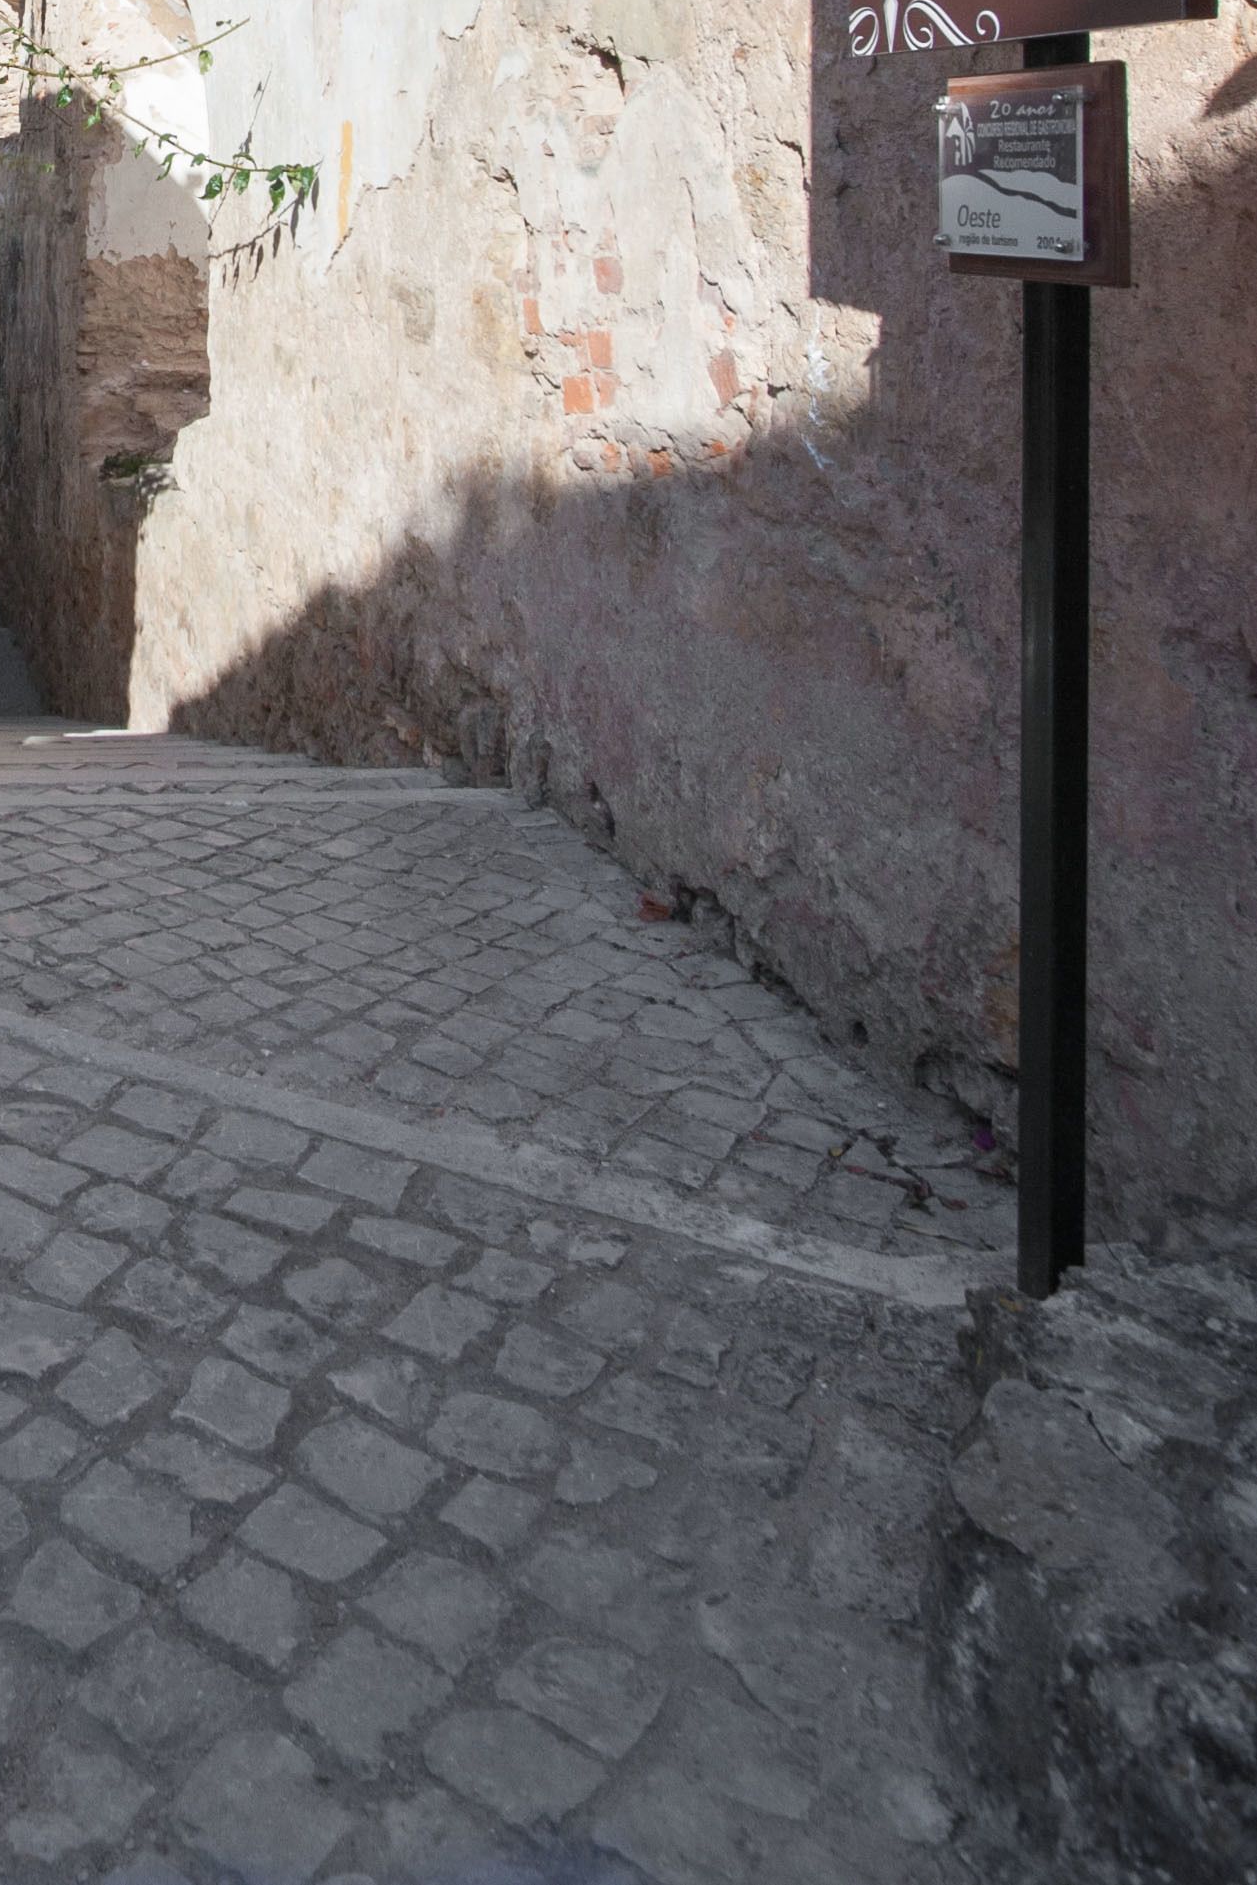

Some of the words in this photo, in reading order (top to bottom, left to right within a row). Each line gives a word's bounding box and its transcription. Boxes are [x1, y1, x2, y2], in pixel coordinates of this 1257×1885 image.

[989, 99, 1012, 119] 20
[1015, 103, 1056, 117] anos
[998, 139, 1052, 153] Restaurante
[993, 155, 1056, 169] Recomendado
[957, 204, 1002, 229] Oeste
